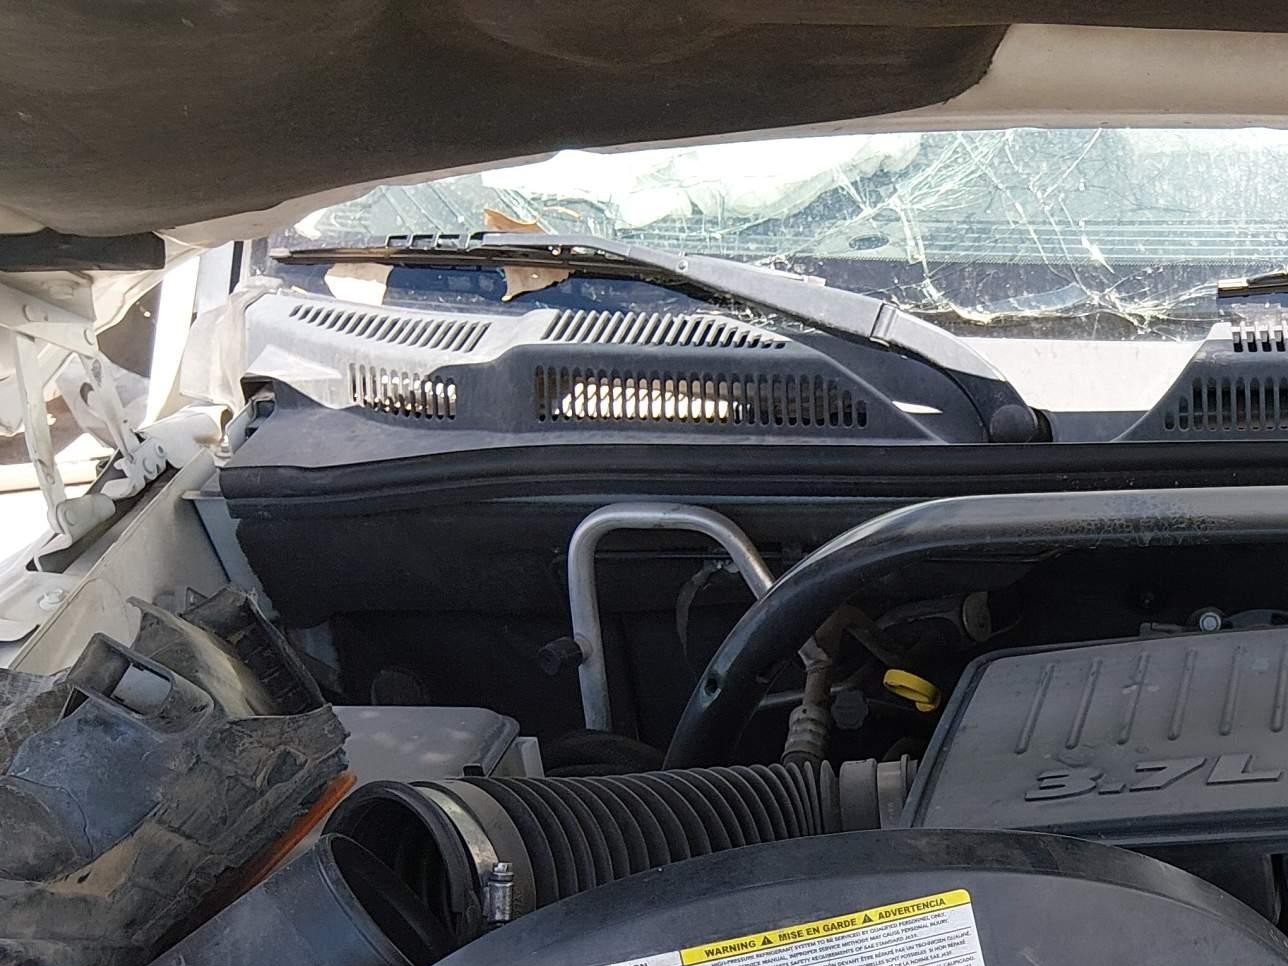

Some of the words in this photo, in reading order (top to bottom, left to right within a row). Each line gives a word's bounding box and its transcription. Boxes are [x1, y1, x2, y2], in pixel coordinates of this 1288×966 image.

[1024, 753, 1283, 801] 3.7L
[704, 939, 756, 957] WARNING
[778, 928, 803, 941] MISE
[805, 925, 820, 935] EN
[822, 917, 857, 931] GARDE
[789, 947, 817, 958] IMPROPER
[818, 942, 840, 951] SERVICE
[841, 936, 868, 946] METHODS
[882, 929, 899, 937] CAUSE
[901, 923, 928, 933] PERSONAL
[794, 940, 815, 949] SYSTEM
[834, 931, 860, 940] SERVICED
[869, 922, 897, 933] QUALIFIED
[898, 915, 930, 926] PERSONNEL
[790, 957, 809, 965] SAFETY
[811, 947, 853, 961] REQUIREMENTS
[875, 936, 904, 947] STANDARD
